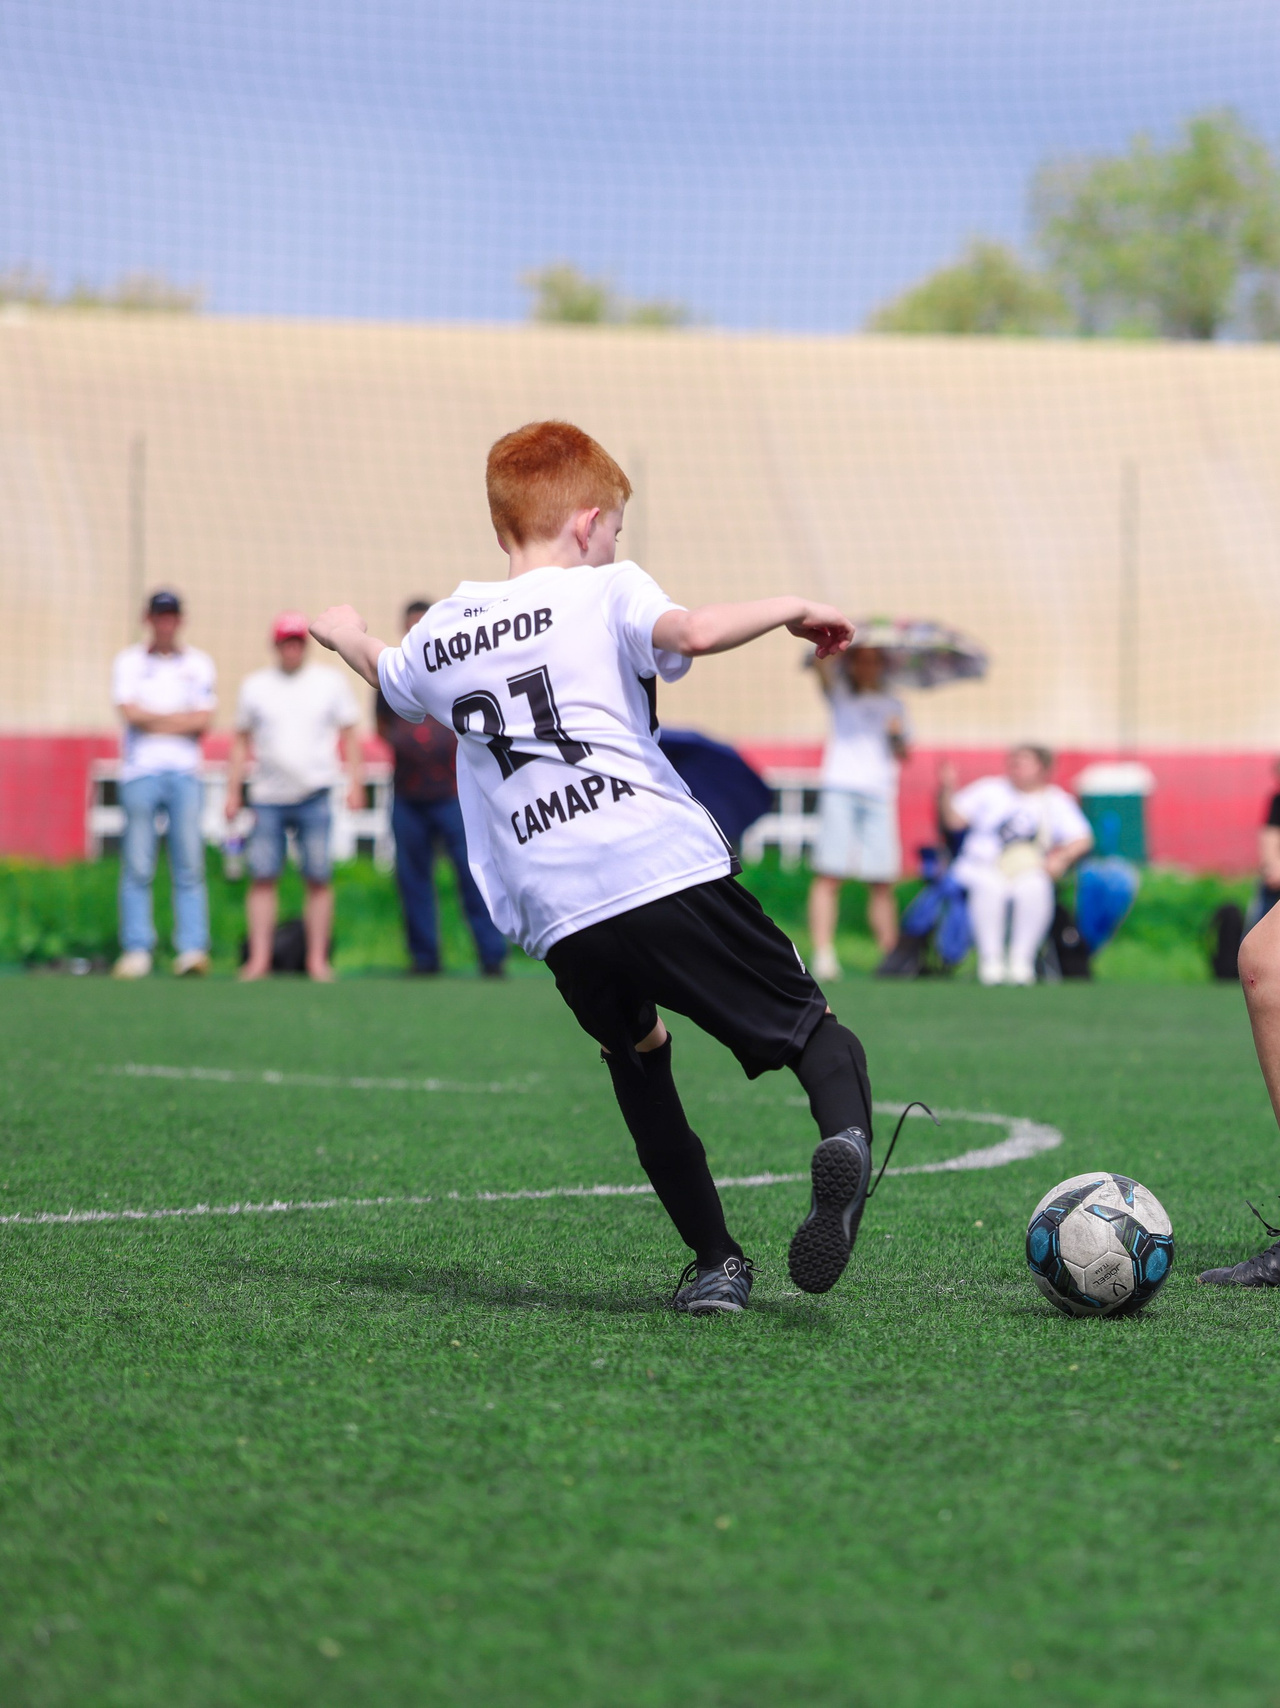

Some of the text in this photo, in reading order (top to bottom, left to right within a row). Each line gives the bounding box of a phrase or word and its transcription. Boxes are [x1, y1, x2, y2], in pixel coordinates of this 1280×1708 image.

[423, 607, 553, 673] САФАРОВ
[451, 665, 593, 781] 21
[510, 775, 636, 845] САМАРА
